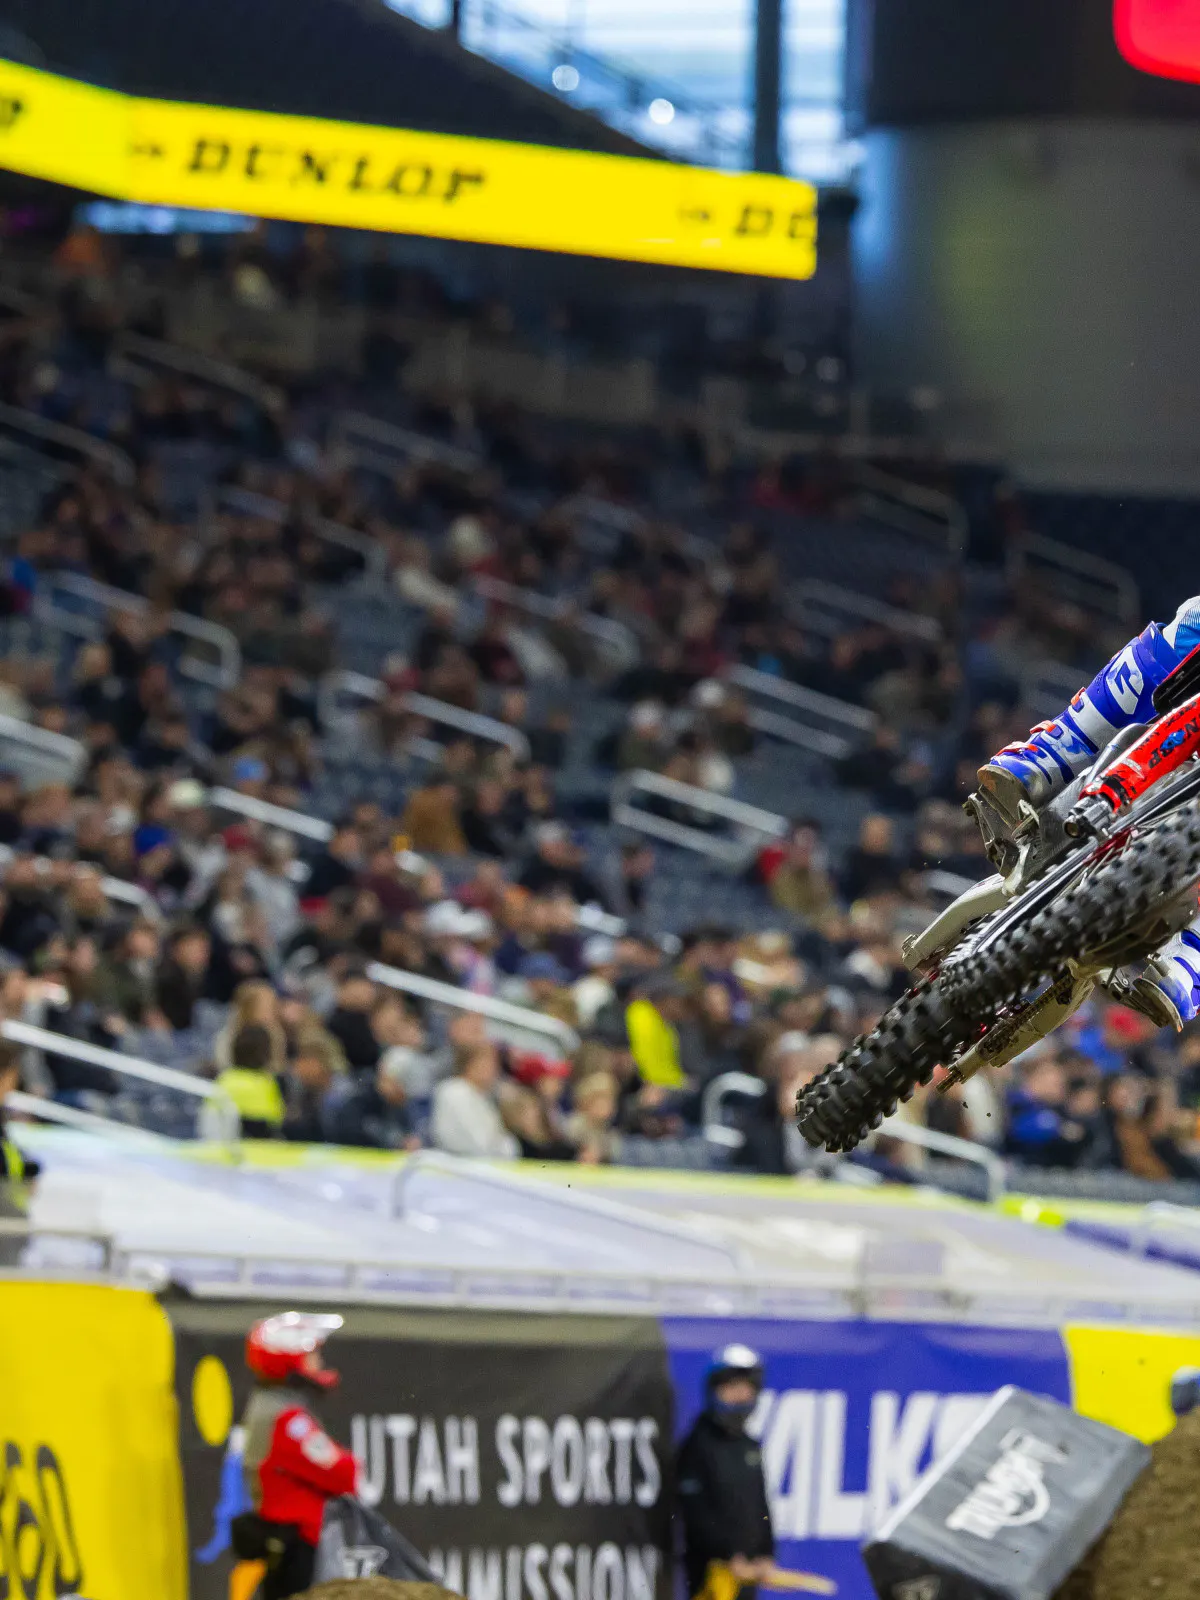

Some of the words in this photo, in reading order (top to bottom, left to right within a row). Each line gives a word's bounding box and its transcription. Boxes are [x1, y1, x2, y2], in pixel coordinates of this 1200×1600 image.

[186, 138, 487, 203] DUNLOP
[350, 1413, 482, 1507] UTAH
[495, 1413, 663, 1508] SPORTS
